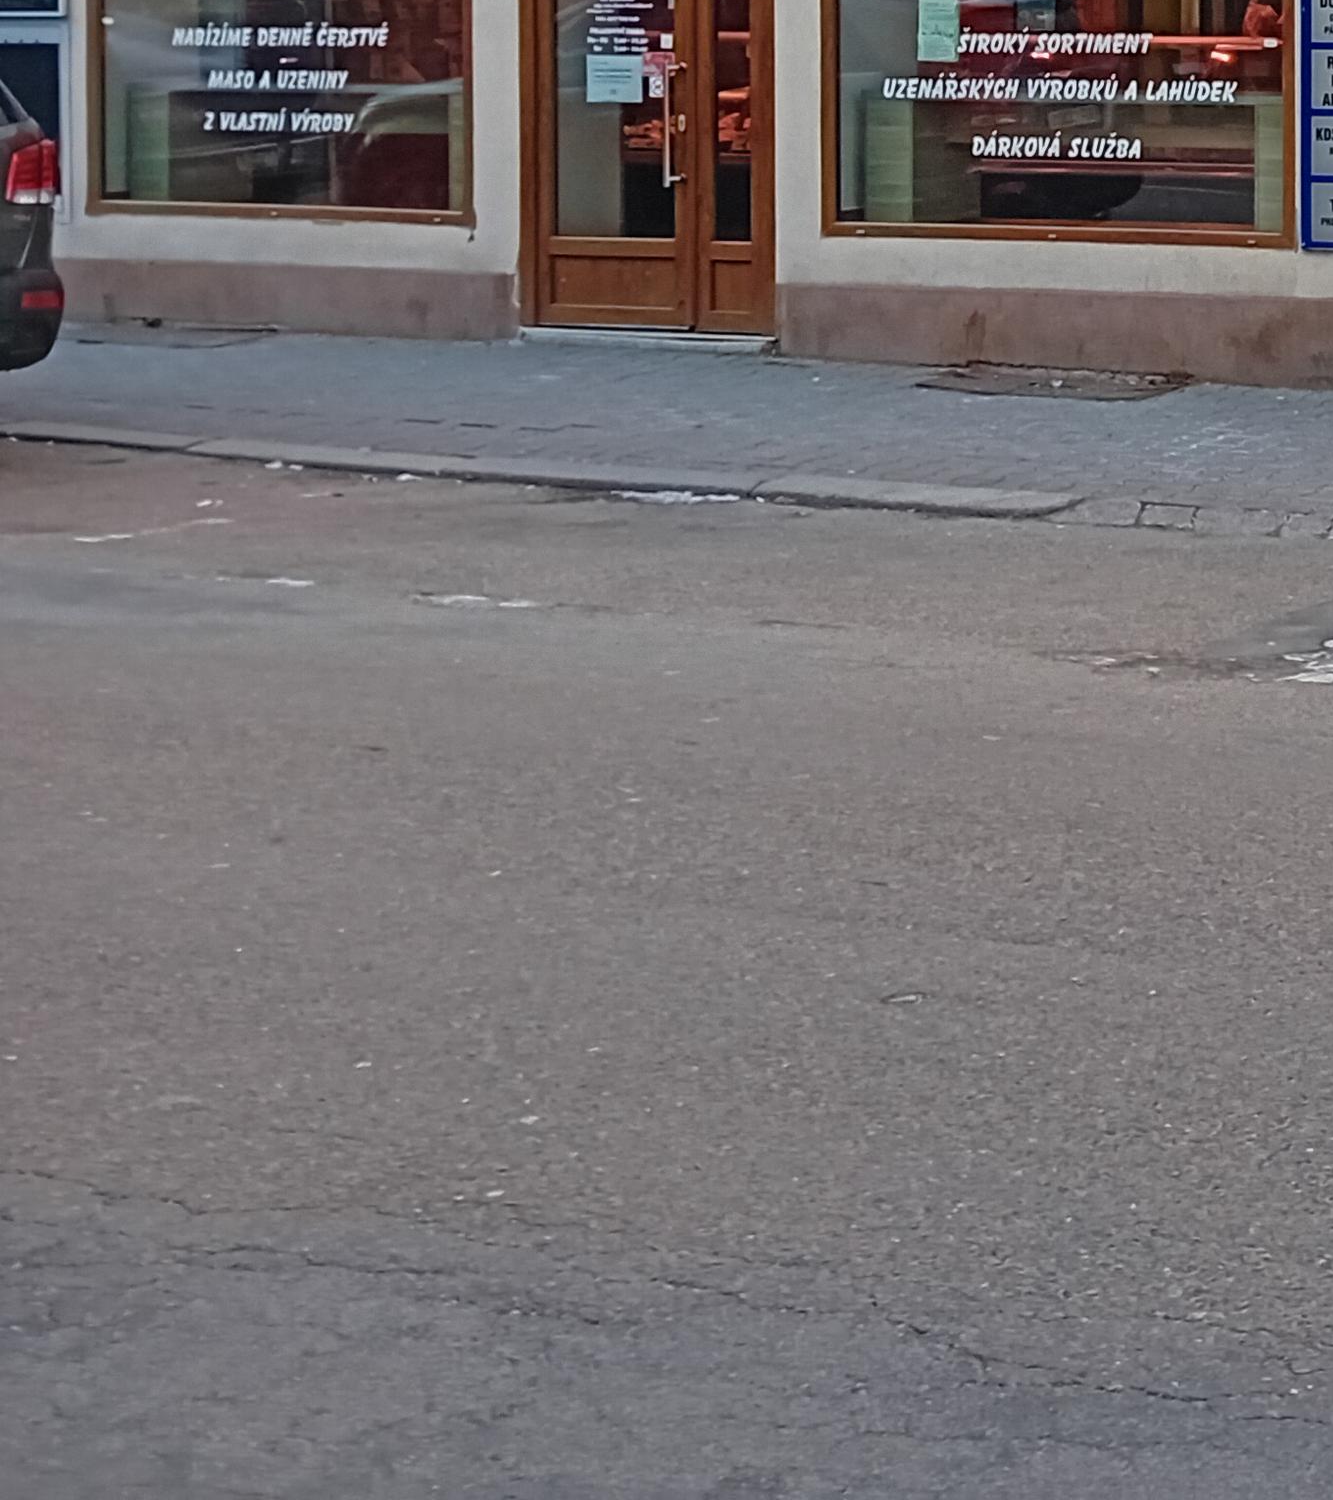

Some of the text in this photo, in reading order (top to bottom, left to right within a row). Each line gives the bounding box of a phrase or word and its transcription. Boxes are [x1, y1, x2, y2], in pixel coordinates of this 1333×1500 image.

[172, 21, 389, 48] NABÍZÍME DENNĚ ČERSTVÉ
[957, 26, 1153, 55] ŠIROKÝ SORTIMENT
[207, 70, 349, 90] MASO A UZENINY
[883, 72, 1239, 103] UZENÁŘSKÝCH VÝROBKŮ A LAHŮDEK
[203, 107, 354, 133] Z VLASTNÍ VÝROBY
[971, 131, 1142, 160] DÁRKOVÁ SLUŽBA
